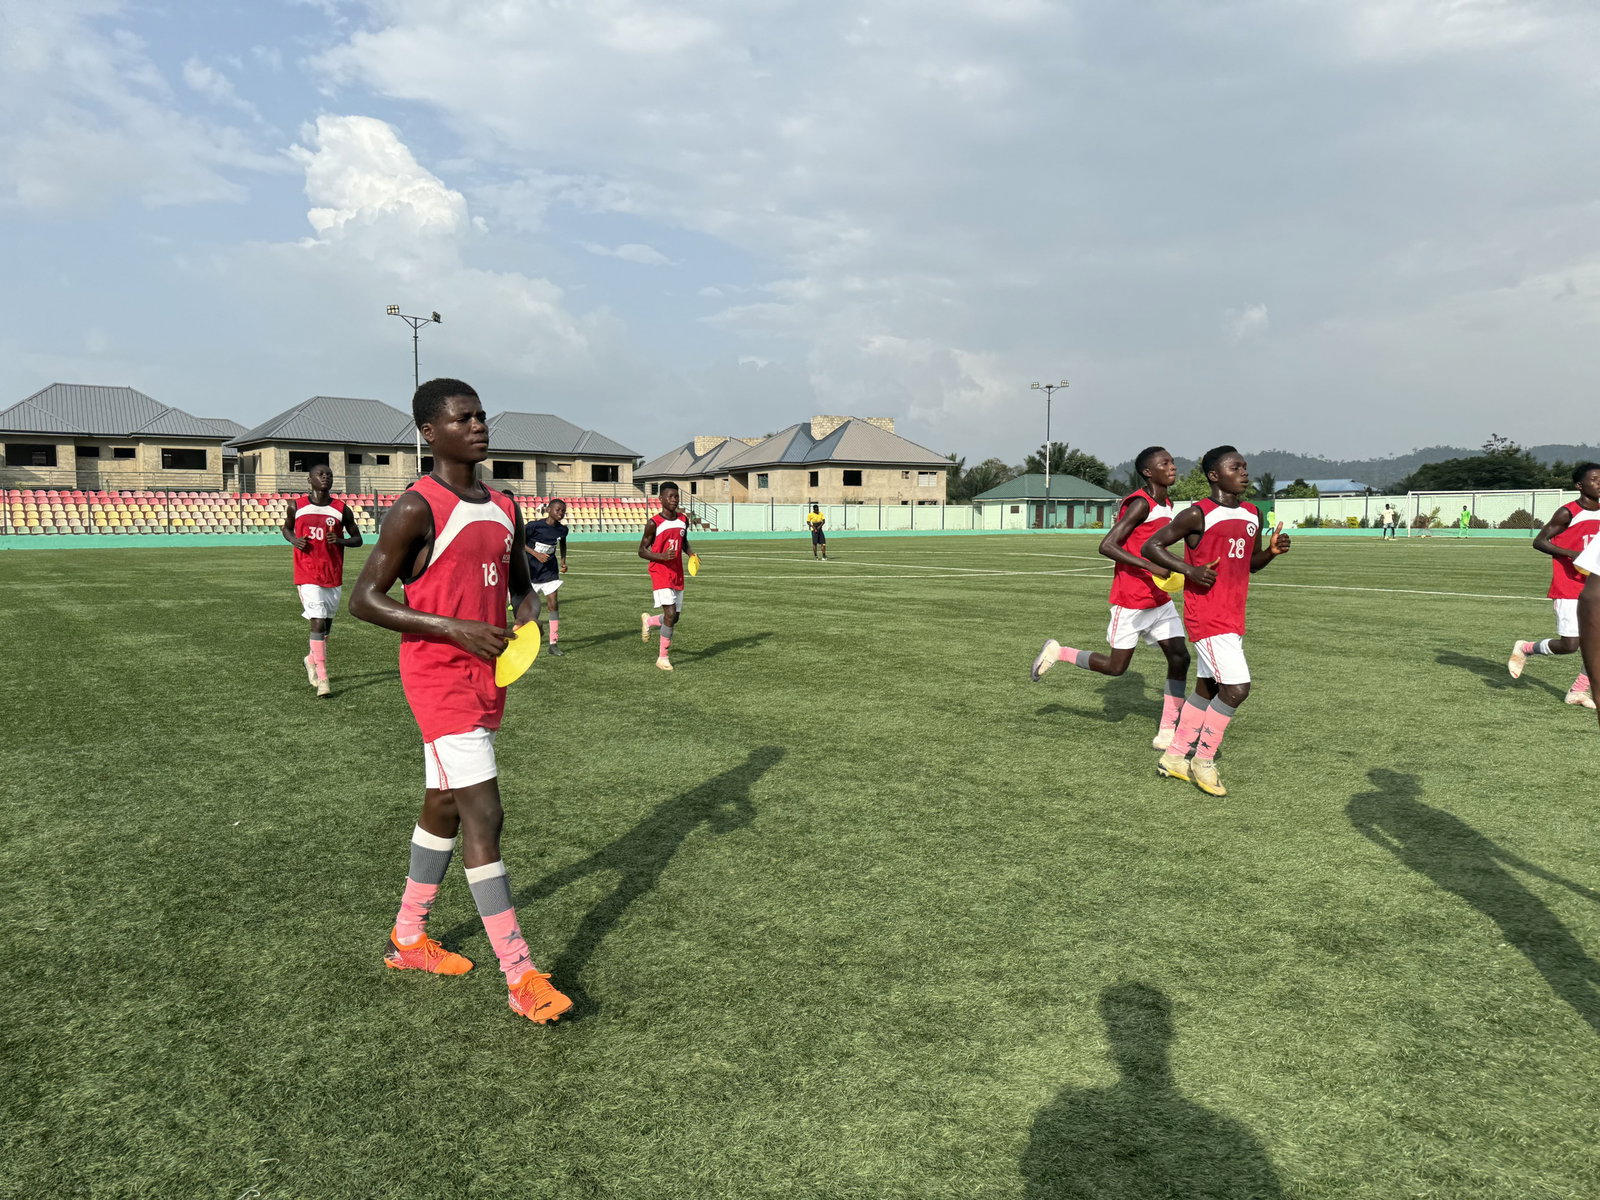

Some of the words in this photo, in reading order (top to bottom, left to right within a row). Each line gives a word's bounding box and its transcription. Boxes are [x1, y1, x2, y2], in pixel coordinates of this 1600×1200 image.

[308, 526, 324, 541] 30
[668, 539, 679, 551] 31
[1227, 537, 1246, 559] 28
[1582, 534, 1595, 549] 1
[481, 562, 498, 587] 18
